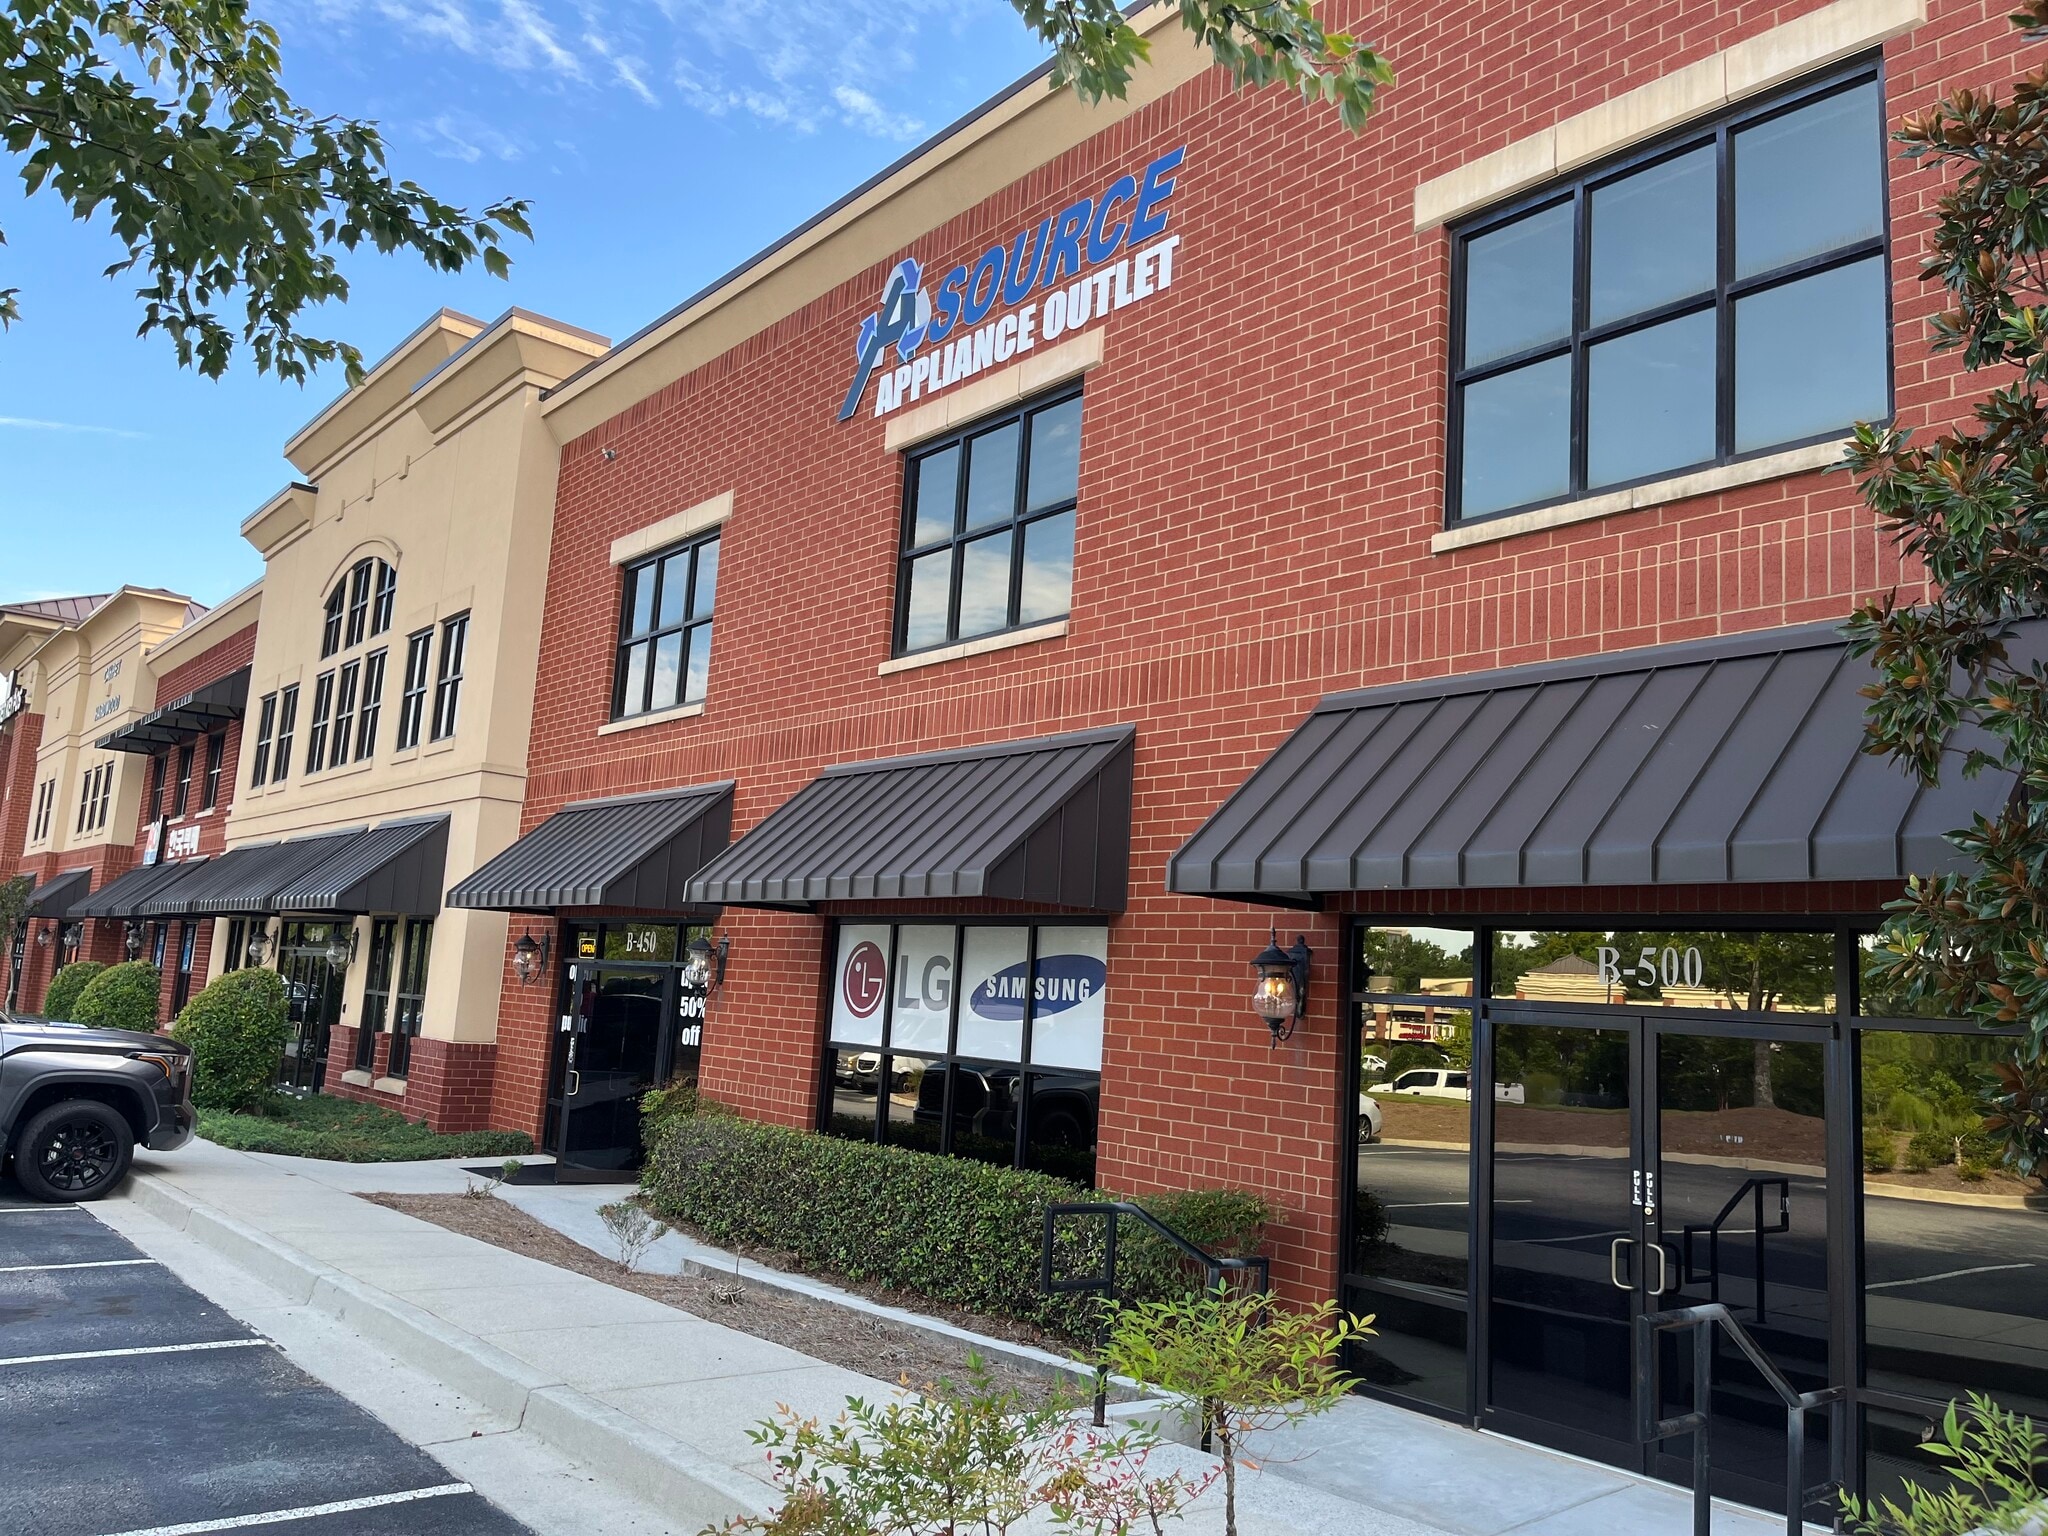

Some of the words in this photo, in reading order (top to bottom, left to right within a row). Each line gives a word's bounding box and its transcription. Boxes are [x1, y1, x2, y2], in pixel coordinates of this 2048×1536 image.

[929, 145, 1187, 343] SOURCE
[874, 303, 1037, 418] APPLIANCE
[1042, 234, 1180, 341] OUTLET
[581, 943, 596, 953] OPEN
[625, 931, 657, 953] B-450
[1595, 946, 1703, 988] B-500
[898, 954, 951, 1012] LG
[986, 975, 1091, 1002] SAMSUNG
[680, 996, 706, 1019] 50%
[681, 1025, 701, 1046] off
[1633, 1170, 1641, 1201] PULL
[1645, 1172, 1654, 1204] PULL
